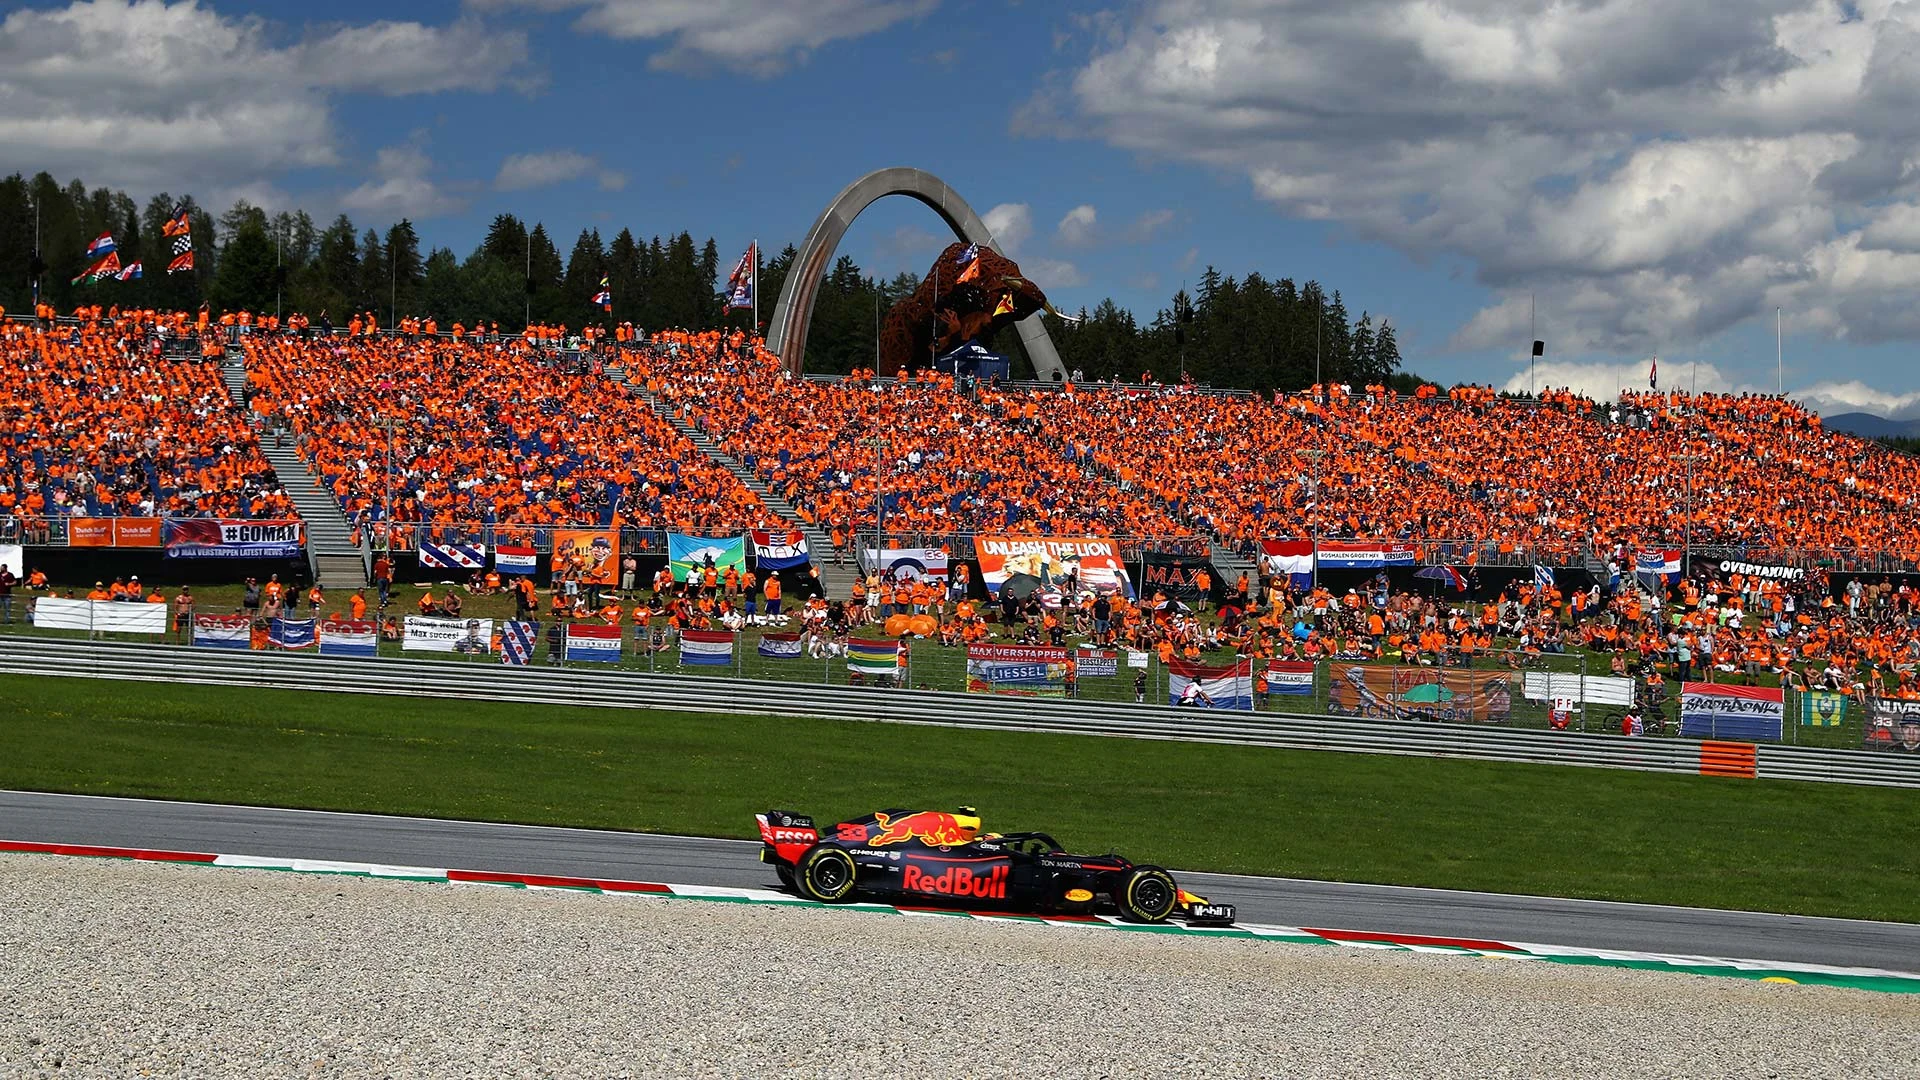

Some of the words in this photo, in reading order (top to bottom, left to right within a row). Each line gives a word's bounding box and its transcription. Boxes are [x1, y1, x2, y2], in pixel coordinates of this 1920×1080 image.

[197, 549, 239, 557] VERSTAPPEN
[758, 542, 803, 558] MAX
[924, 550, 945, 560] 33
[982, 540, 1048, 556] UNLEASH
[1047, 541, 1075, 556] THE
[1076, 543, 1113, 557] LION
[1145, 564, 1202, 587] MAX
[1720, 560, 1804, 582] OVERTAKING
[410, 629, 428, 637] Max
[429, 631, 460, 640] succes!
[970, 646, 993, 656] MAX
[995, 648, 1066, 659] VERSTAPPEN
[991, 666, 1045, 680] LIESSEL
[1391, 670, 1450, 690] MAX
[1366, 703, 1474, 721] CHAMPON
[775, 830, 815, 845] ESSO
[837, 823, 868, 841] 33
[1056, 861, 1082, 869] MARTIN
[1194, 904, 1223, 917] Mobil
